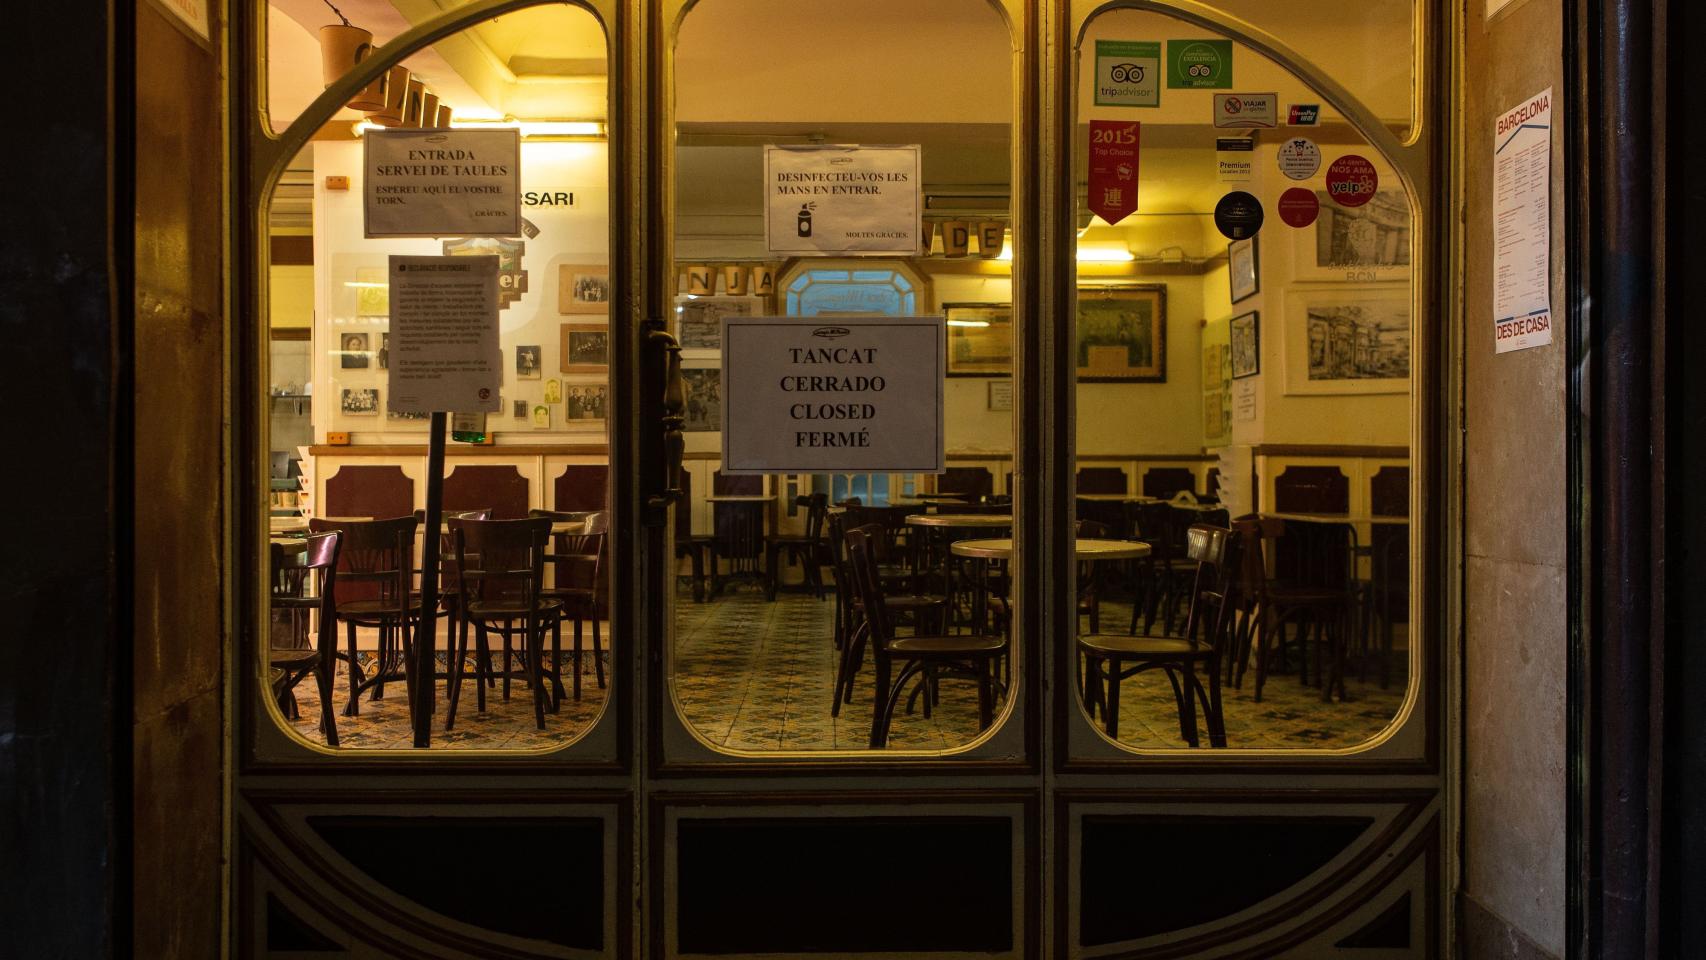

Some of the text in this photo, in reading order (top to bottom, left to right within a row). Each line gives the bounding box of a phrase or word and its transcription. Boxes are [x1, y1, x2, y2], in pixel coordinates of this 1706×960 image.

[1101, 87, 1151, 98] tripadvisor
[1498, 95, 1549, 135] BARCELONA
[1093, 127, 1136, 145] 2015
[409, 150, 475, 161] ENTRADA
[1094, 147, 1134, 156] Top Choice
[376, 165, 507, 176] SERVEI DE TAULES
[1331, 166, 1374, 175] NOS AMA
[777, 172, 908, 182] DESINFECTEU-VOS LES
[376, 185, 420, 194] ESPEREU
[448, 185, 461, 194] EL
[463, 185, 503, 194] VOSTRE
[777, 185, 882, 195] MANS EN ENTRAR.
[1332, 181, 1360, 195] yelp
[376, 196, 406, 205] TORN.
[845, 231, 874, 239] MOLTES
[1346, 271, 1376, 281] BCN
[1497, 315, 1550, 340] DES DE CASA
[789, 348, 878, 364] TANCAT
[779, 376, 886, 392] CERRADO
[790, 403, 876, 420] CLOSED
[795, 427, 870, 448] FERMÉ
